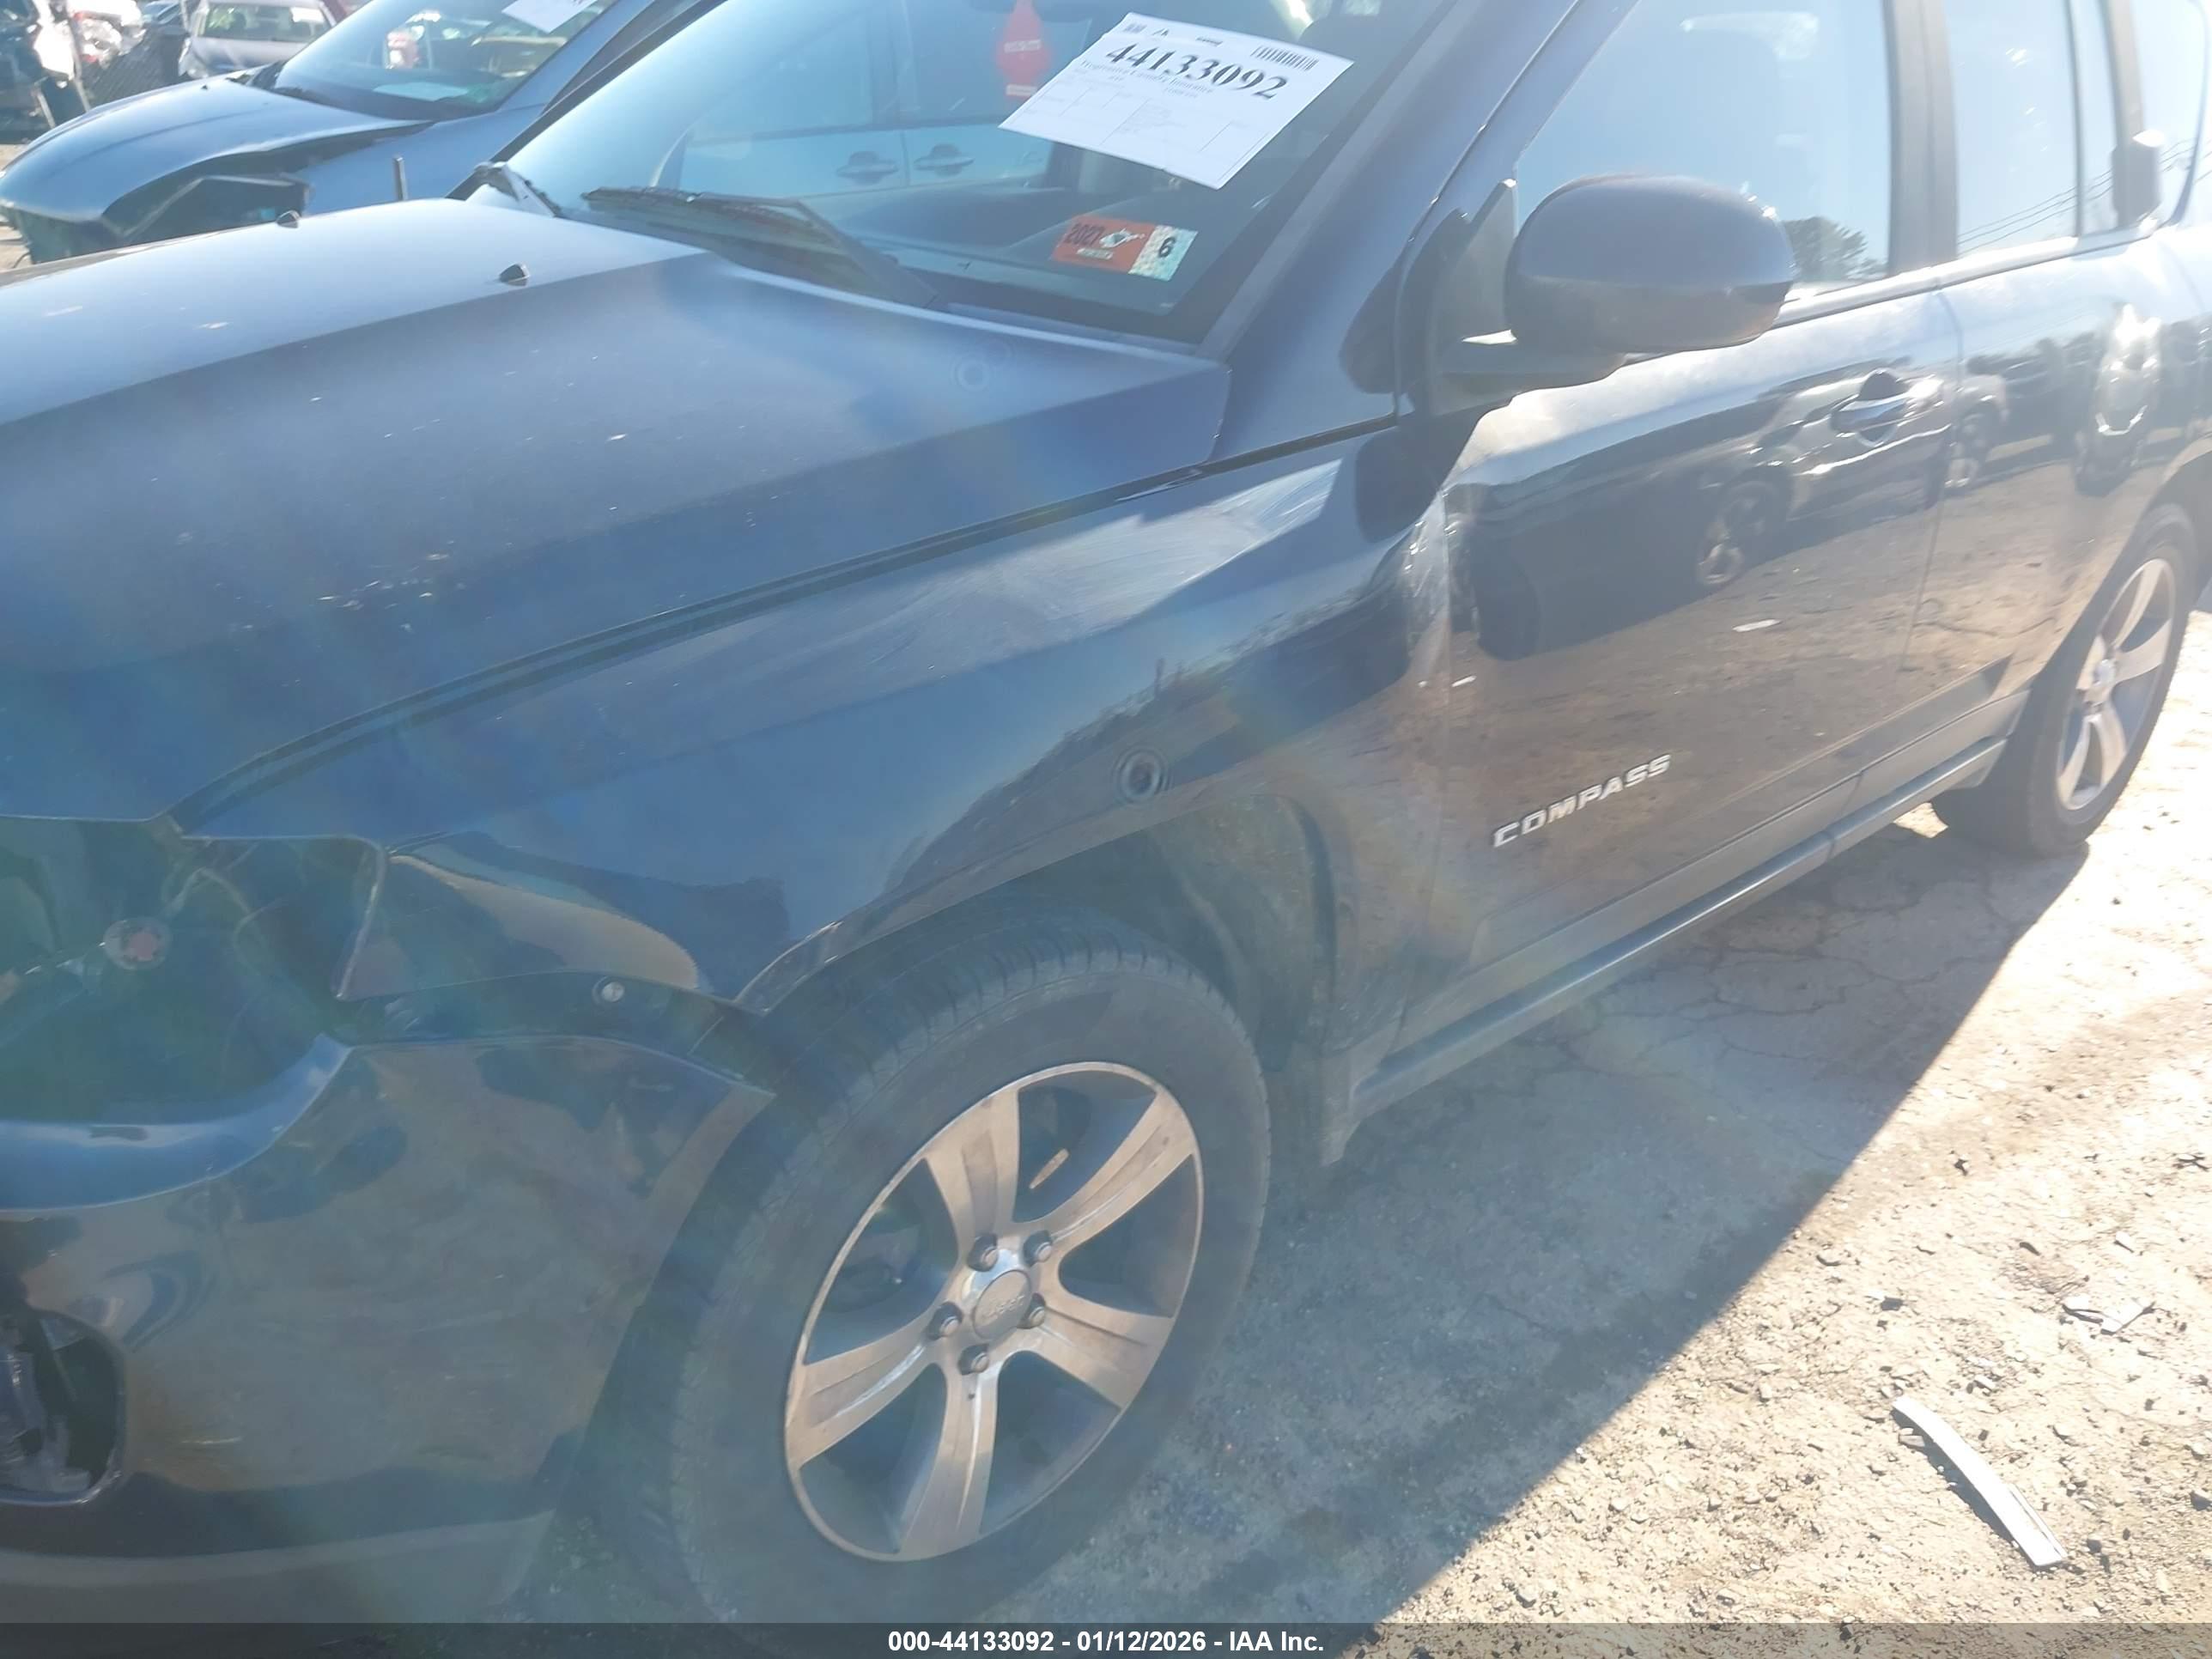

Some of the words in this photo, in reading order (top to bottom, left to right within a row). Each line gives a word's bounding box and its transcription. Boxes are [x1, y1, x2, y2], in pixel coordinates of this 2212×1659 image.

[1105, 42, 1290, 101] 44133092
[1158, 235, 1176, 258] 6
[1492, 753, 1672, 848] COMPASS
